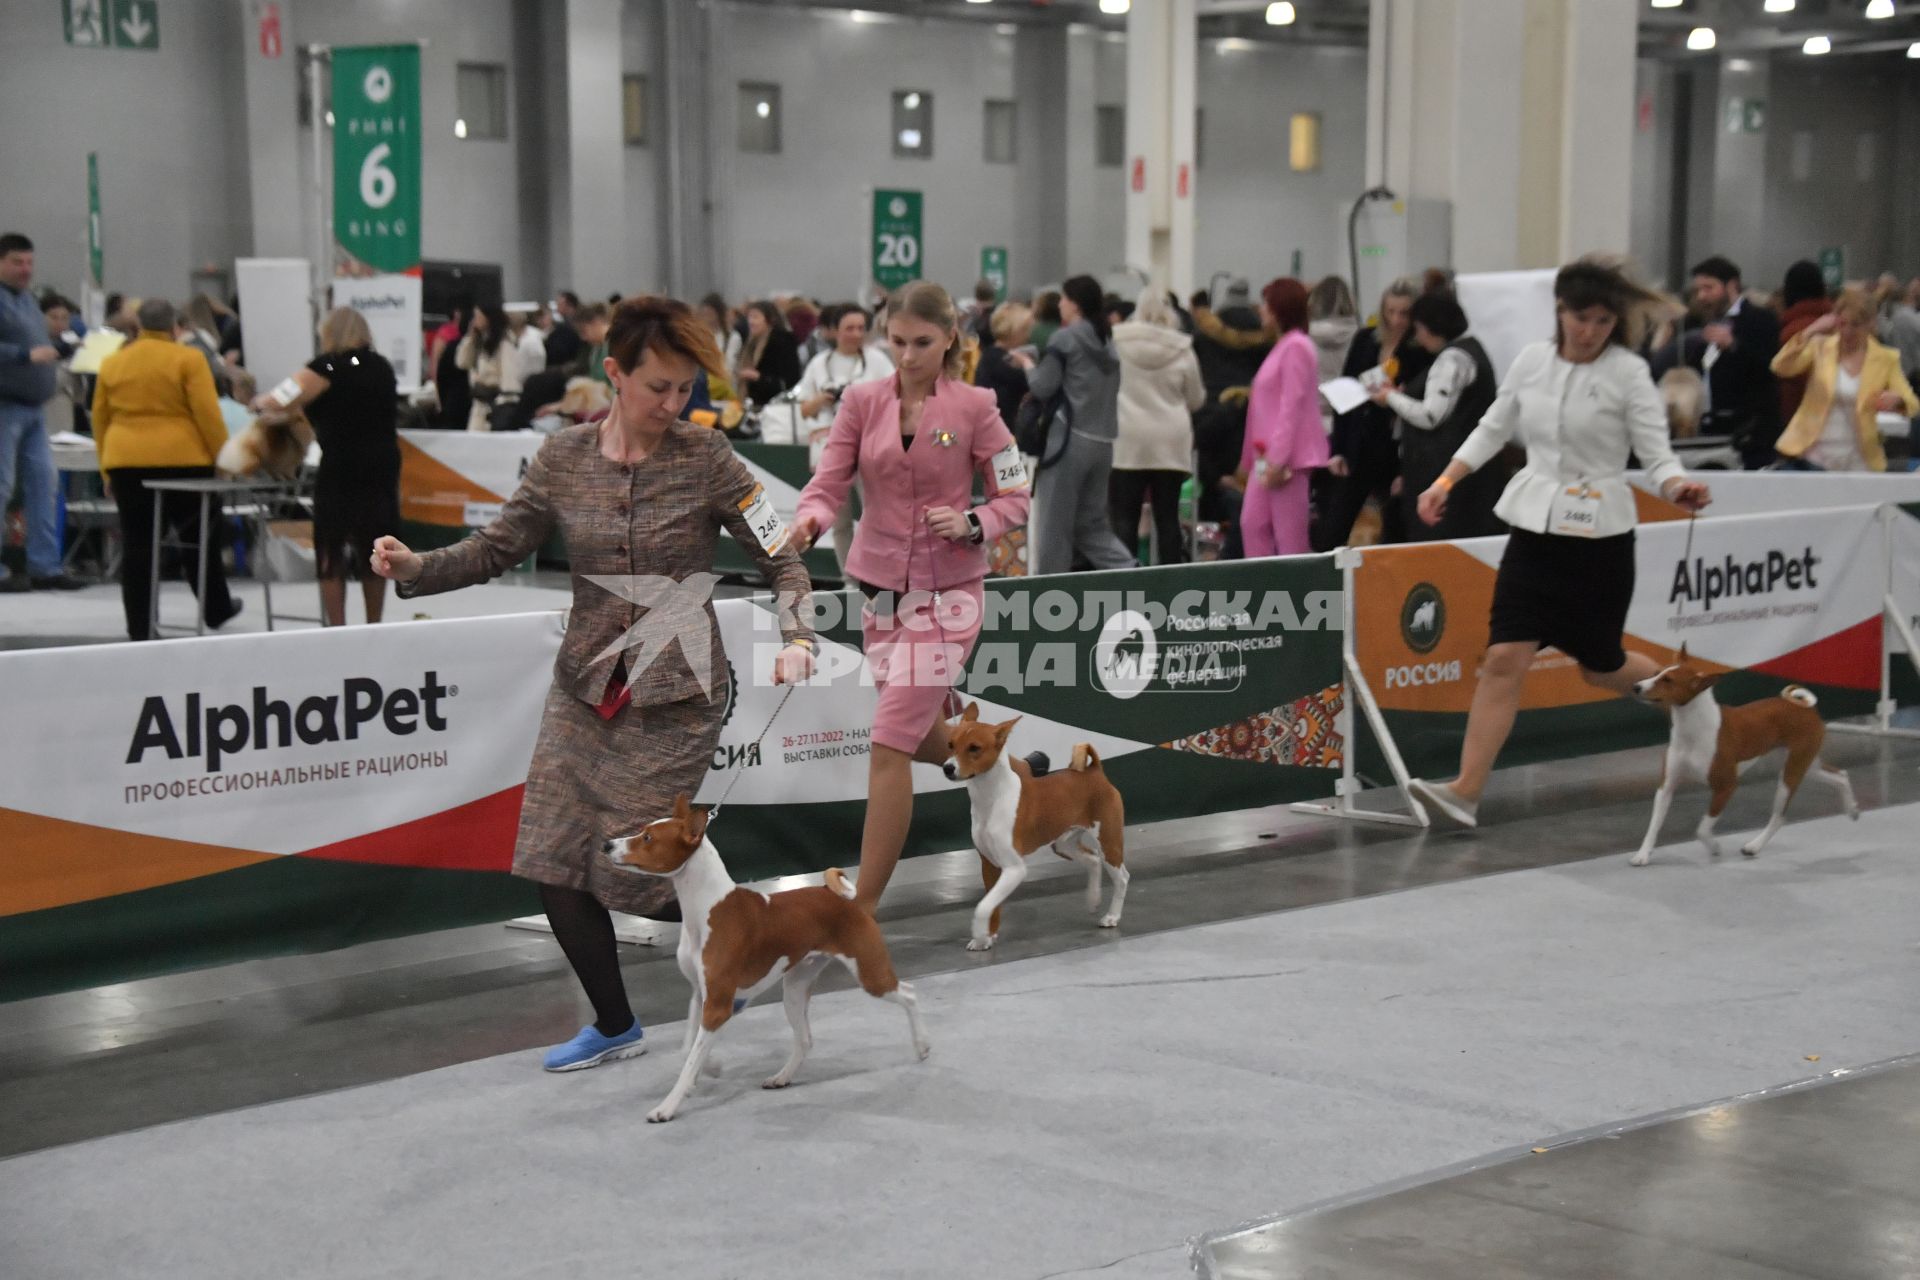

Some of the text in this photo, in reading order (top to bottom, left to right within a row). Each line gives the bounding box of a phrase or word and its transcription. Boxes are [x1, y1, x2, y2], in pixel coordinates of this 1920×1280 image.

[360, 142, 397, 209] 6
[877, 234, 918, 267] 20
[757, 511, 779, 539] 248
[1166, 611, 1250, 632] Российская
[1166, 635, 1283, 658] кинологическая
[1166, 664, 1248, 690] федерация
[1385, 660, 1461, 689] РОССИЯ
[782, 730, 844, 748] 26-27.11.2022
[784, 743, 871, 764] ВЫСТАВКИ СОБА
[125, 750, 449, 804] ПРОФЕССИОНАЛЬНЫЕ РАЦИОНЫ
